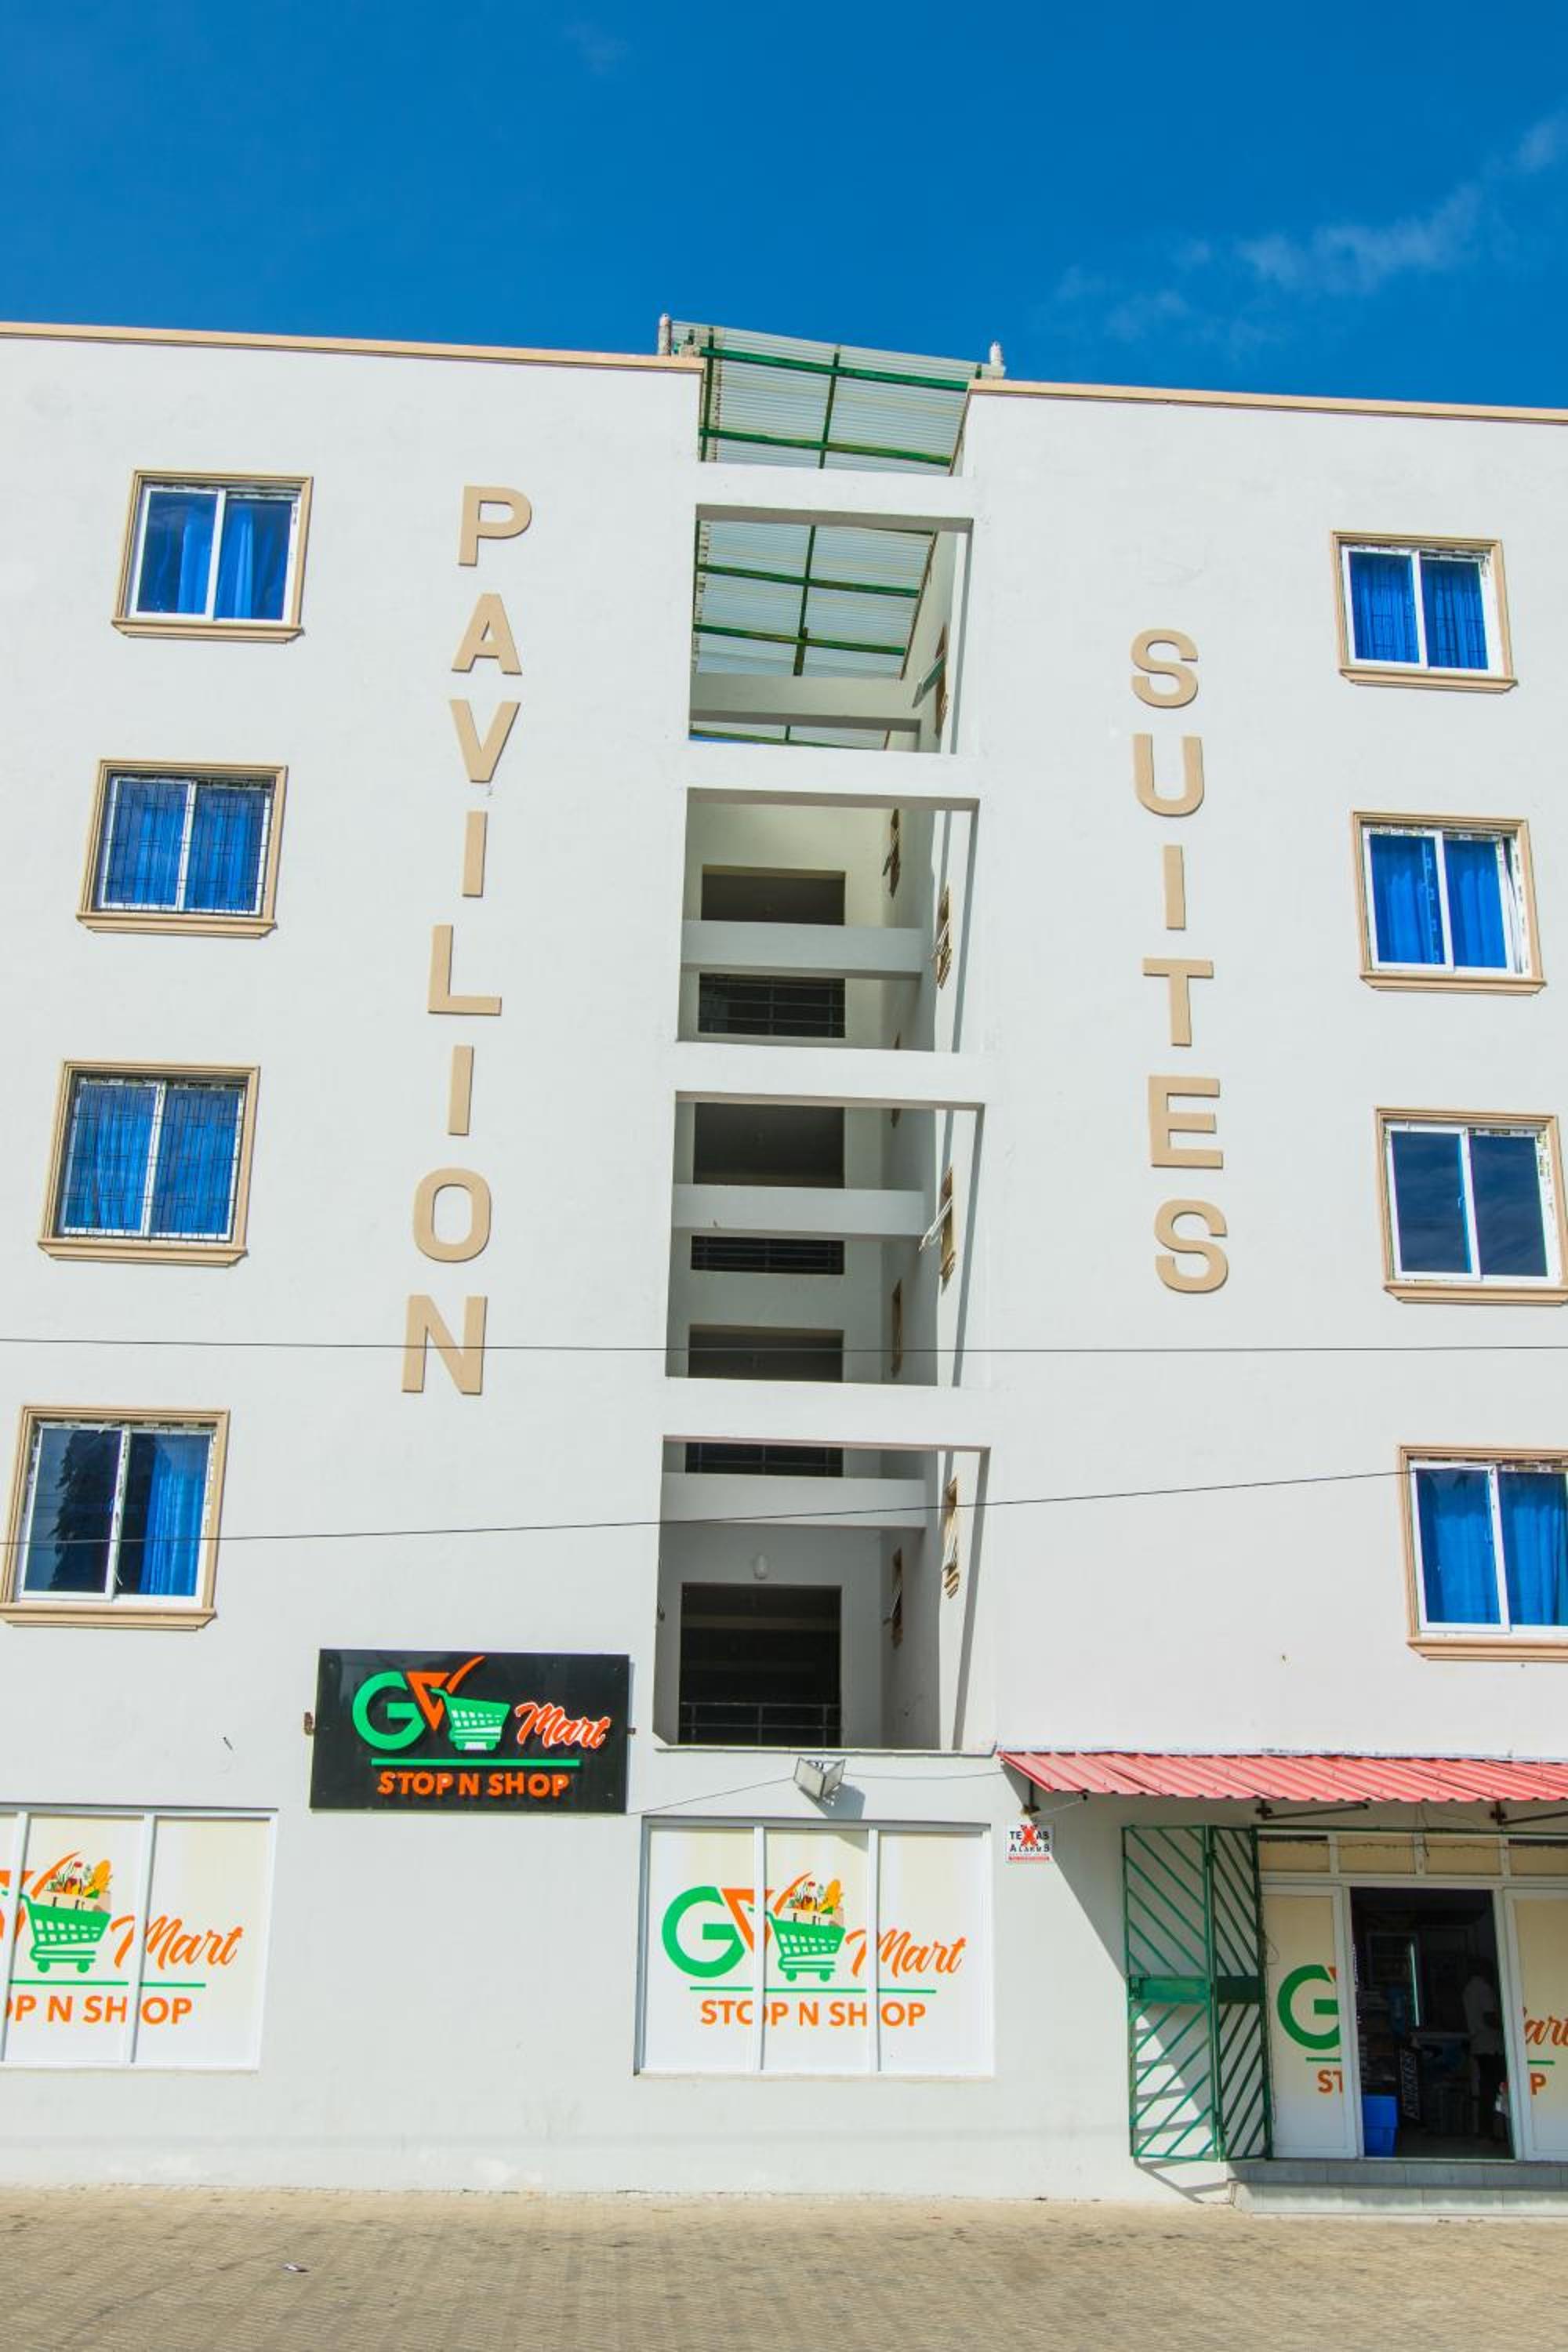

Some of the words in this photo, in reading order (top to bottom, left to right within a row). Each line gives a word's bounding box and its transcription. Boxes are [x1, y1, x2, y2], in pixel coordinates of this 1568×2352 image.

[402, 485, 532, 1396] PAVILION
[1130, 629, 1229, 1294] SUITES
[514, 1701, 612, 1750] Mart
[376, 1770, 452, 1797] STOP
[458, 1772, 481, 1797] N
[486, 1771, 572, 1798] SHOP
[1008, 1824, 1051, 1846] TEXAS
[110, 1915, 244, 1970] Mart
[844, 1928, 967, 1978] Mart
[47, 1995, 74, 2023] N
[83, 1995, 192, 2024] SHOP
[701, 1999, 789, 2027] STOP
[799, 2002, 819, 2027] N
[829, 2001, 926, 2027] SHOP
